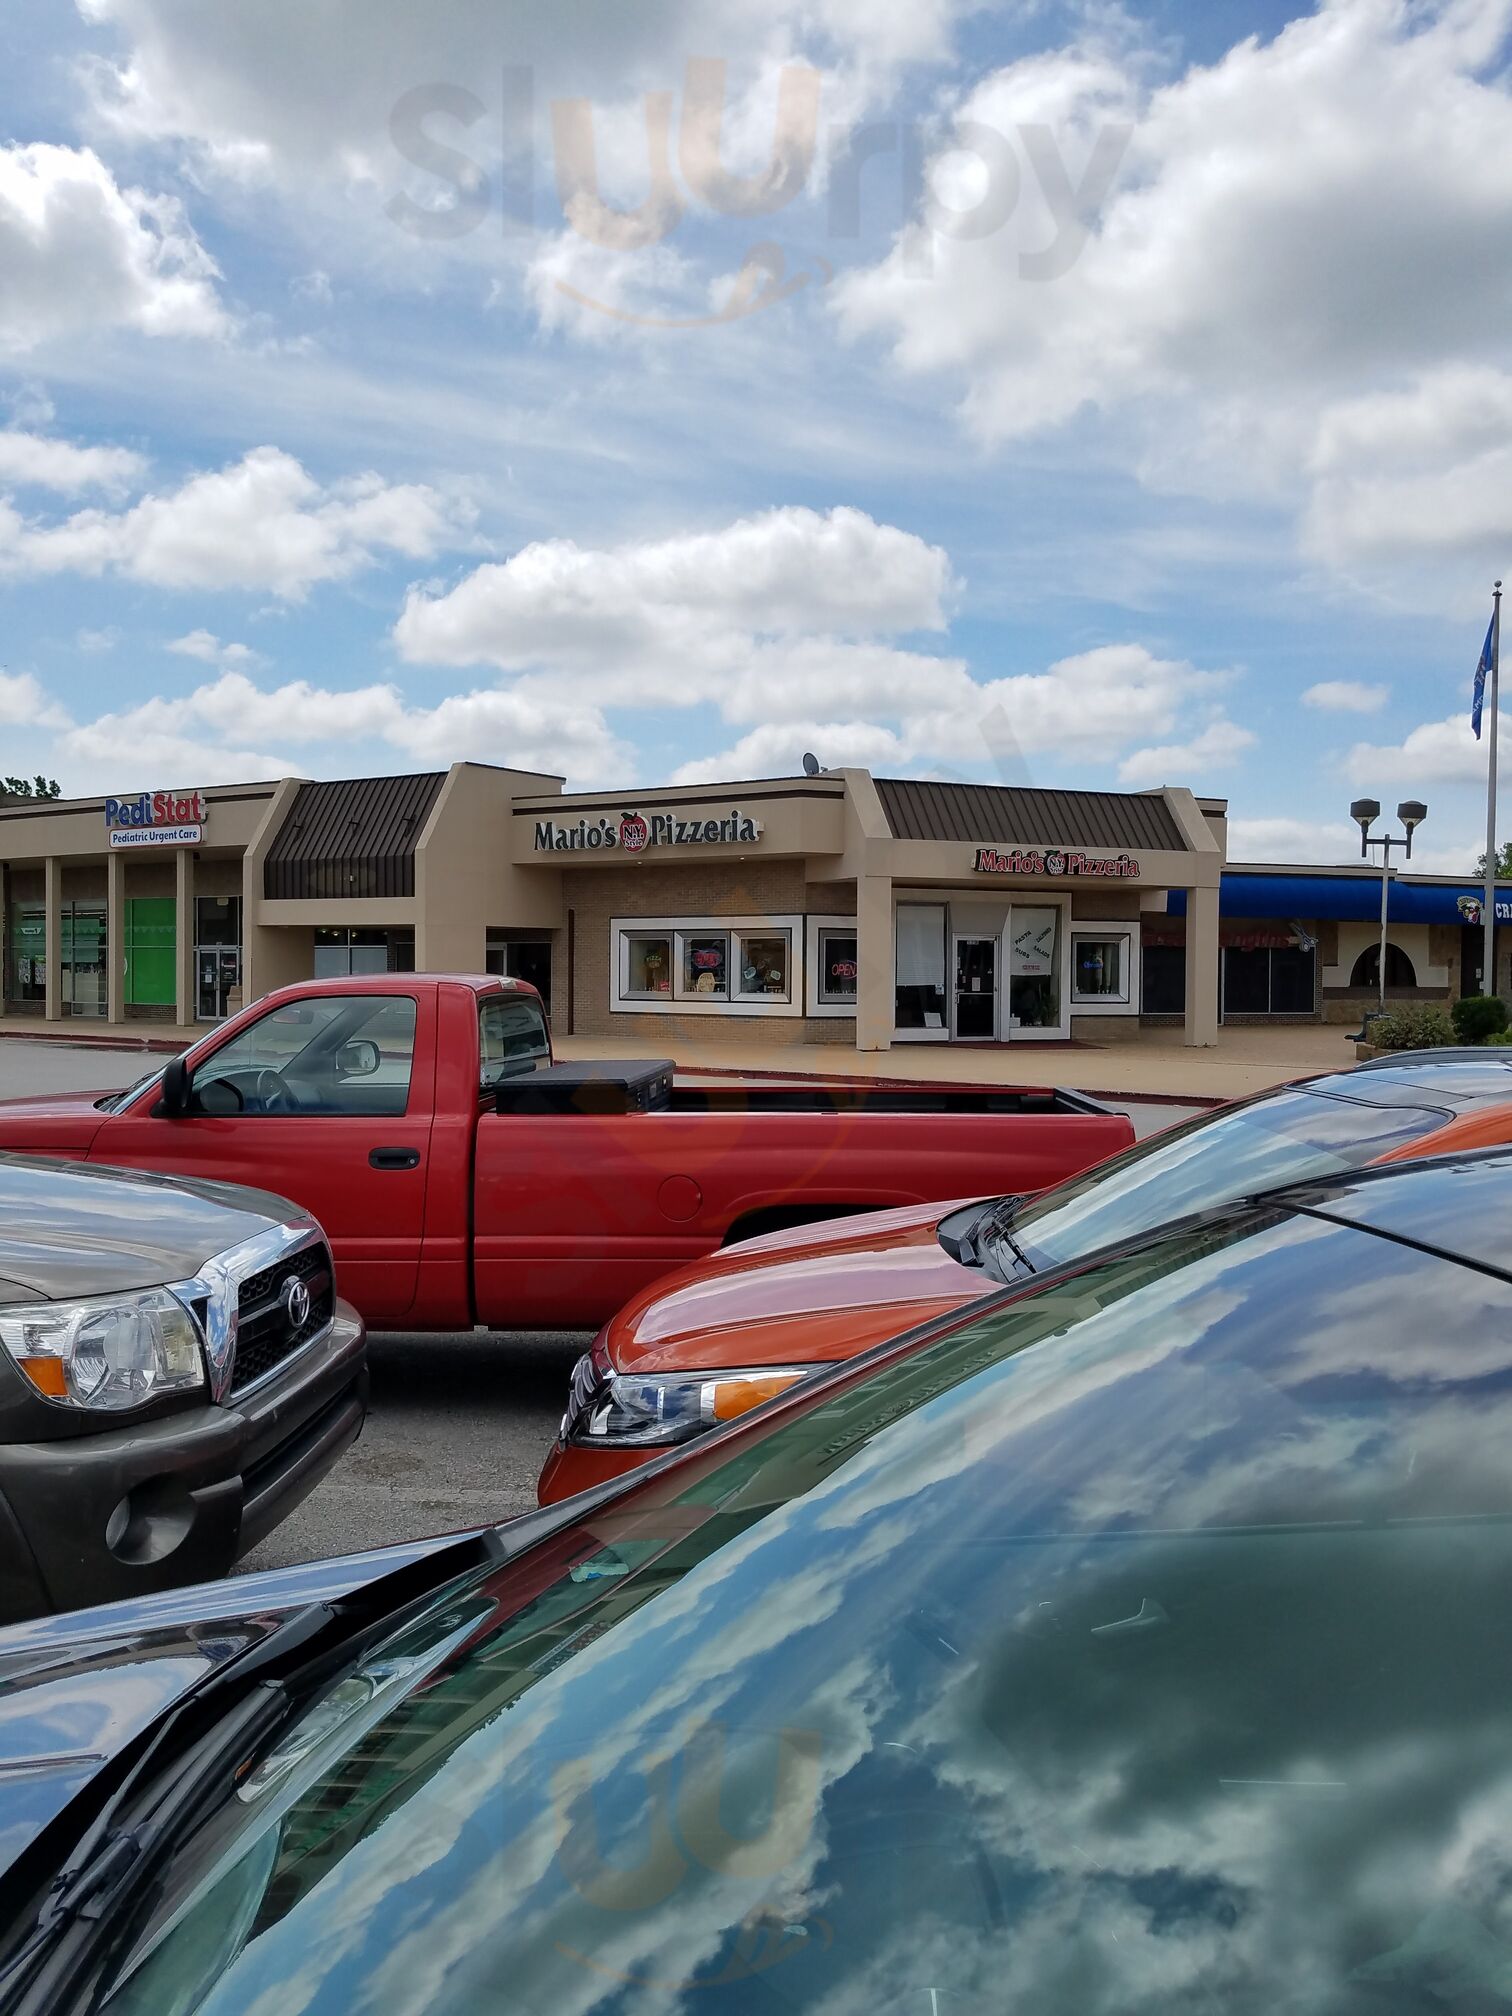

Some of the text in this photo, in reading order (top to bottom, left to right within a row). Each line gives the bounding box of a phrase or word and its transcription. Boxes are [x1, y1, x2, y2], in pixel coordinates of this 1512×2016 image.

[105, 791, 202, 827] PediStat
[112, 829, 198, 843] Pediatric Urgent Care
[534, 810, 757, 850] Mario's Pizzeria
[978, 849, 1140, 877] Mario's Pizzeria
[1015, 930, 1032, 945] PASTA
[1015, 947, 1030, 959] SUBS
[831, 964, 855, 976] OPEN
